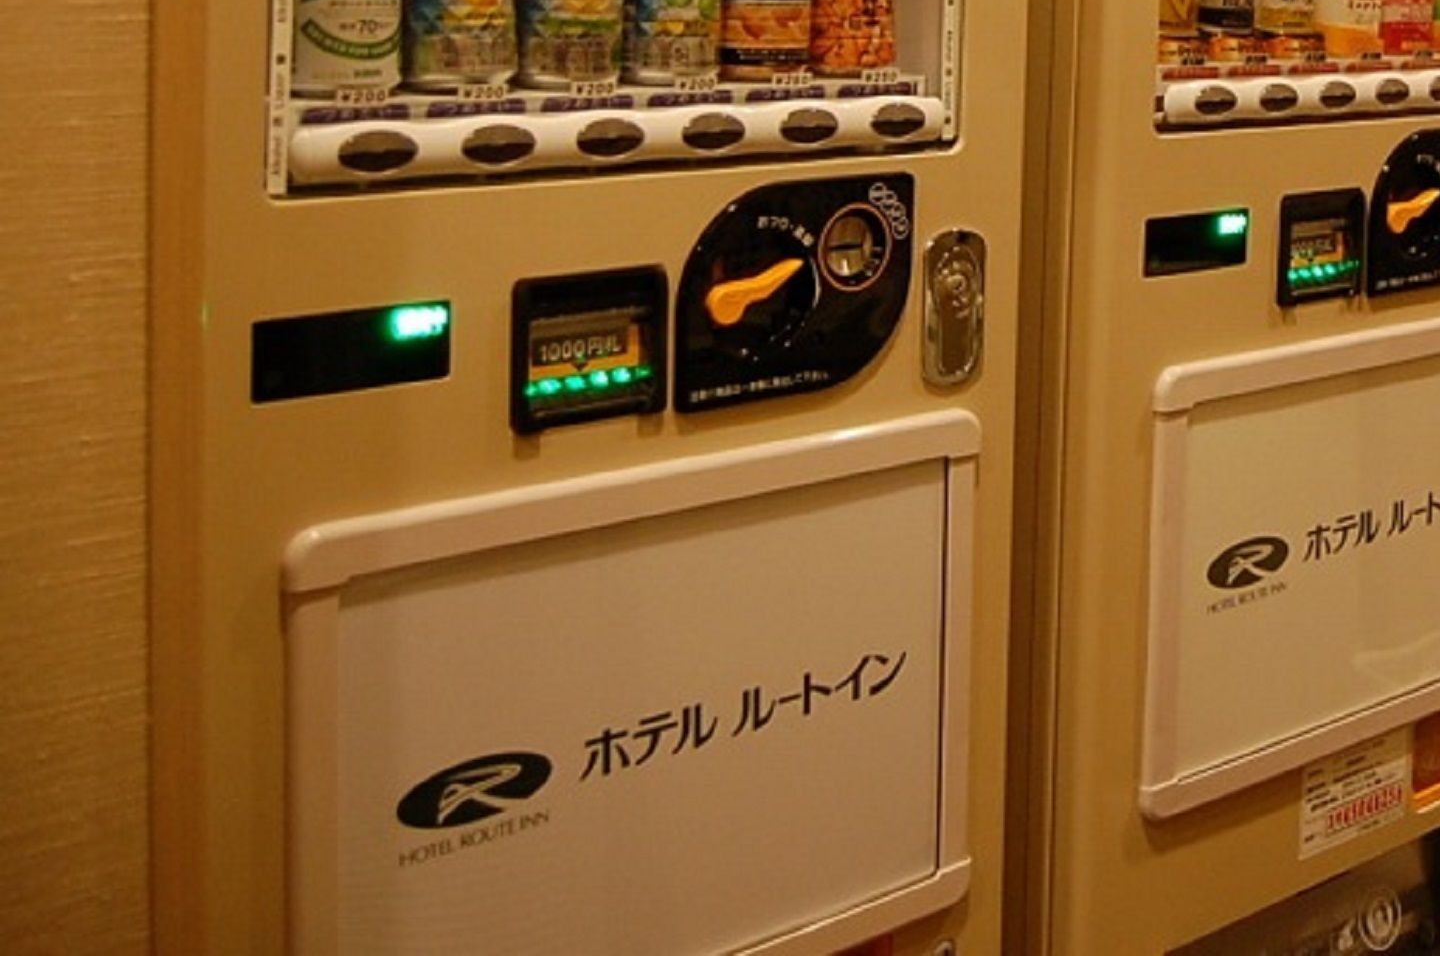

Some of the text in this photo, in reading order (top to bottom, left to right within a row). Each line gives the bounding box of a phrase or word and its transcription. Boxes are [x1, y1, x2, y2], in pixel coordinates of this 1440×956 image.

[1303, 509, 1381, 563] ホテル
[580, 650, 907, 782] ホテル ルートイン
[398, 836, 455, 868] HOTEL
[518, 809, 550, 830] INN
